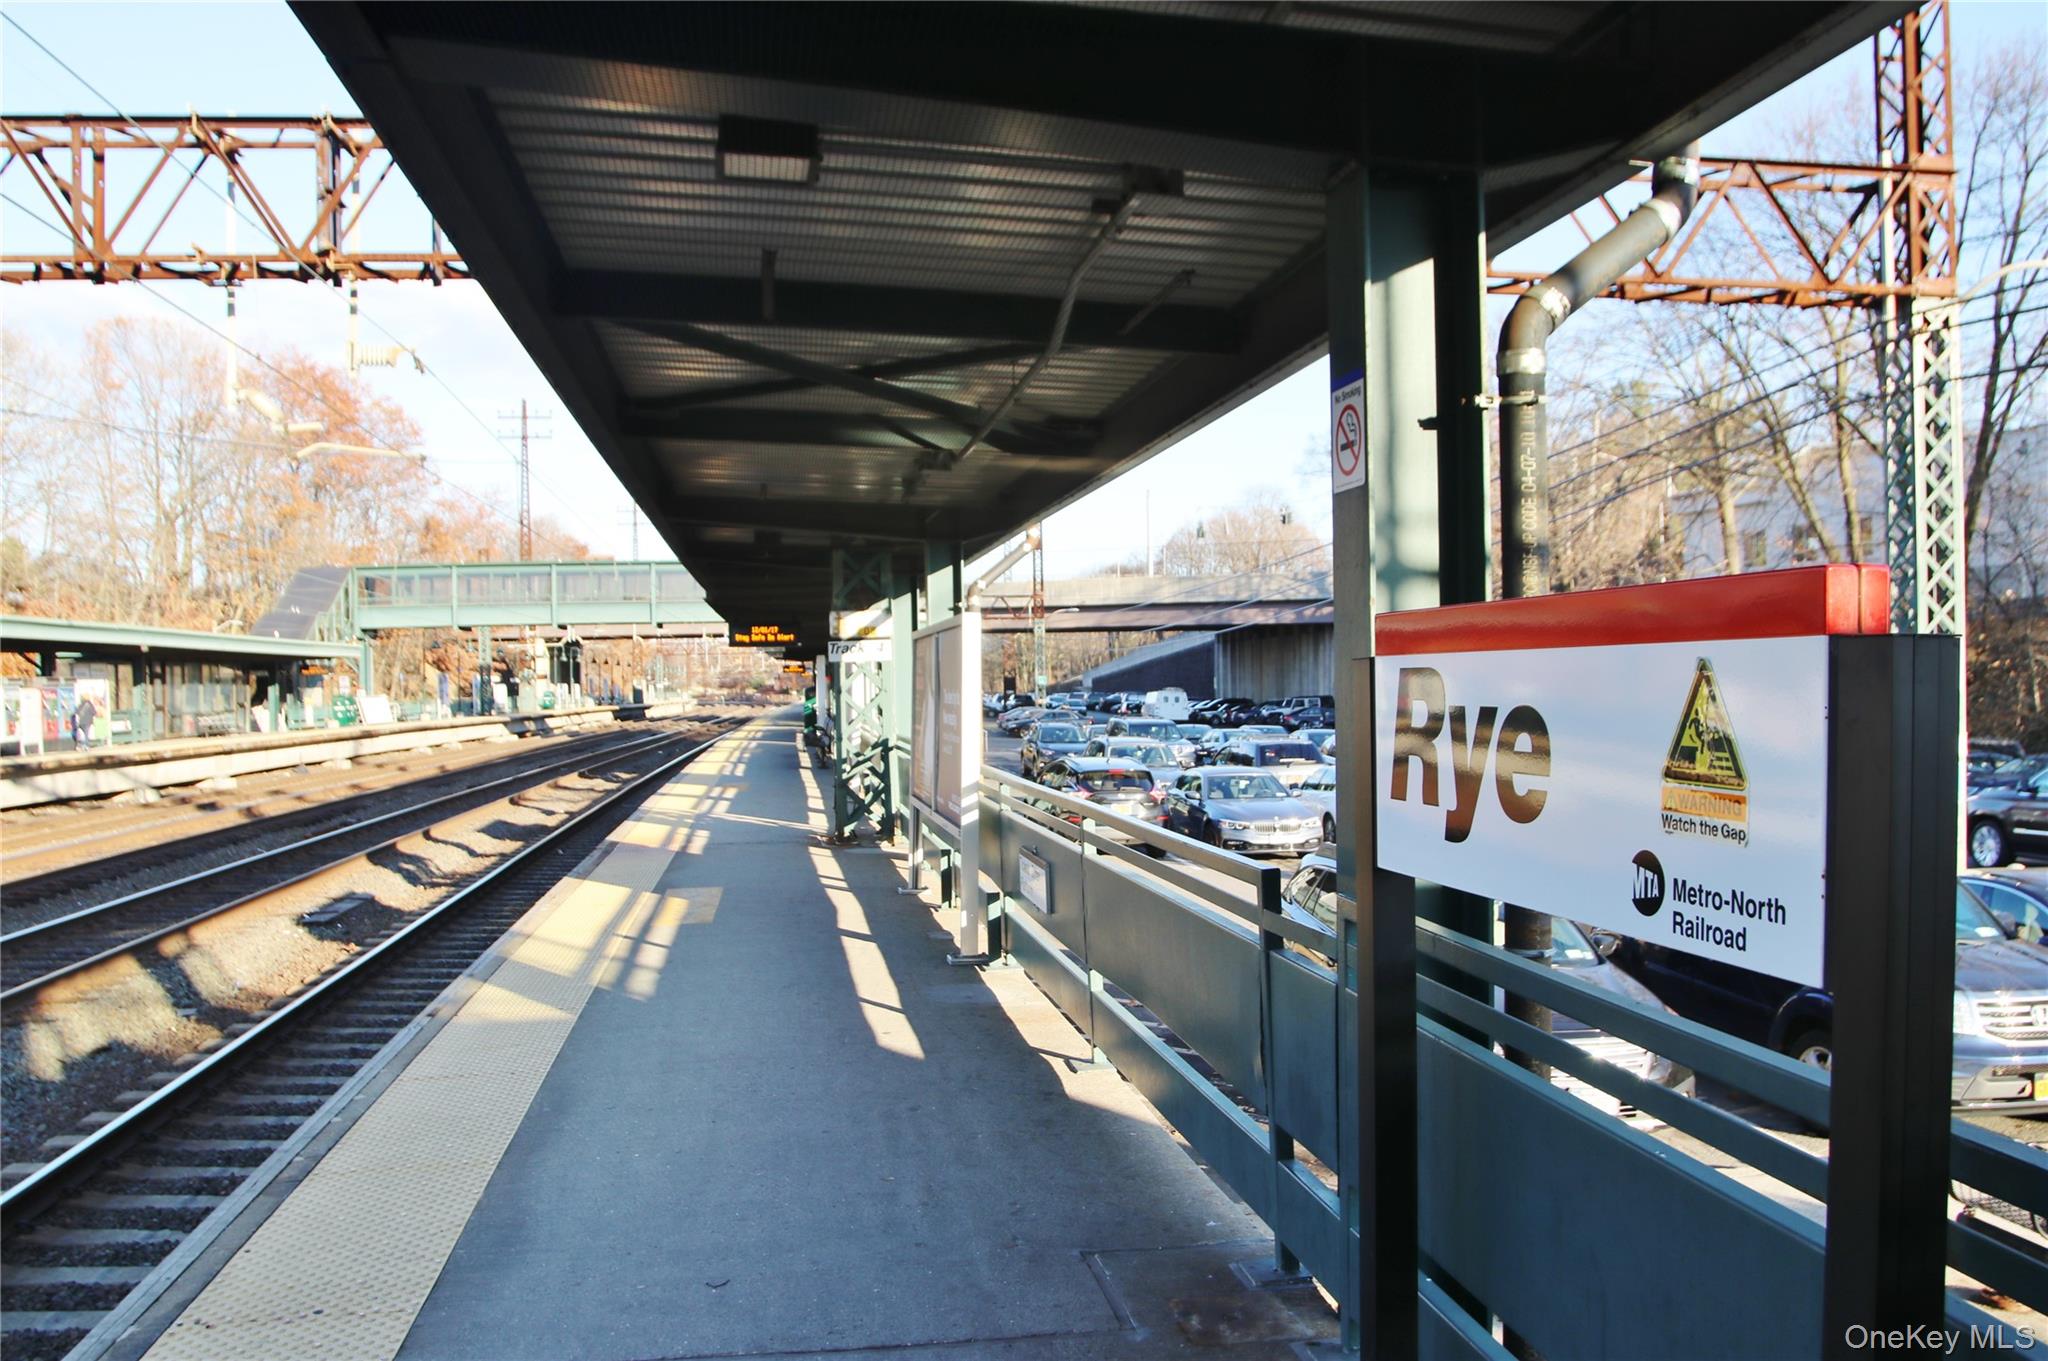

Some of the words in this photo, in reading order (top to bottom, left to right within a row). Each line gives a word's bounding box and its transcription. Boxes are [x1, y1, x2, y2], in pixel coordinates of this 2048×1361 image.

[1341, 385, 1362, 402] Smoking
[1520, 431, 1537, 493] 04-07-10
[1521, 498, 1537, 530] CODE
[1390, 667, 1551, 843] Rye
[1679, 793, 1742, 817] WARNING
[1661, 813, 1697, 834] Watch
[1699, 820, 1719, 837] the
[1720, 823, 1747, 845] Gap
[1631, 862, 1660, 899] MTA
[1672, 877, 1786, 925] Metro-North
[1672, 910, 1747, 952] Railroad
